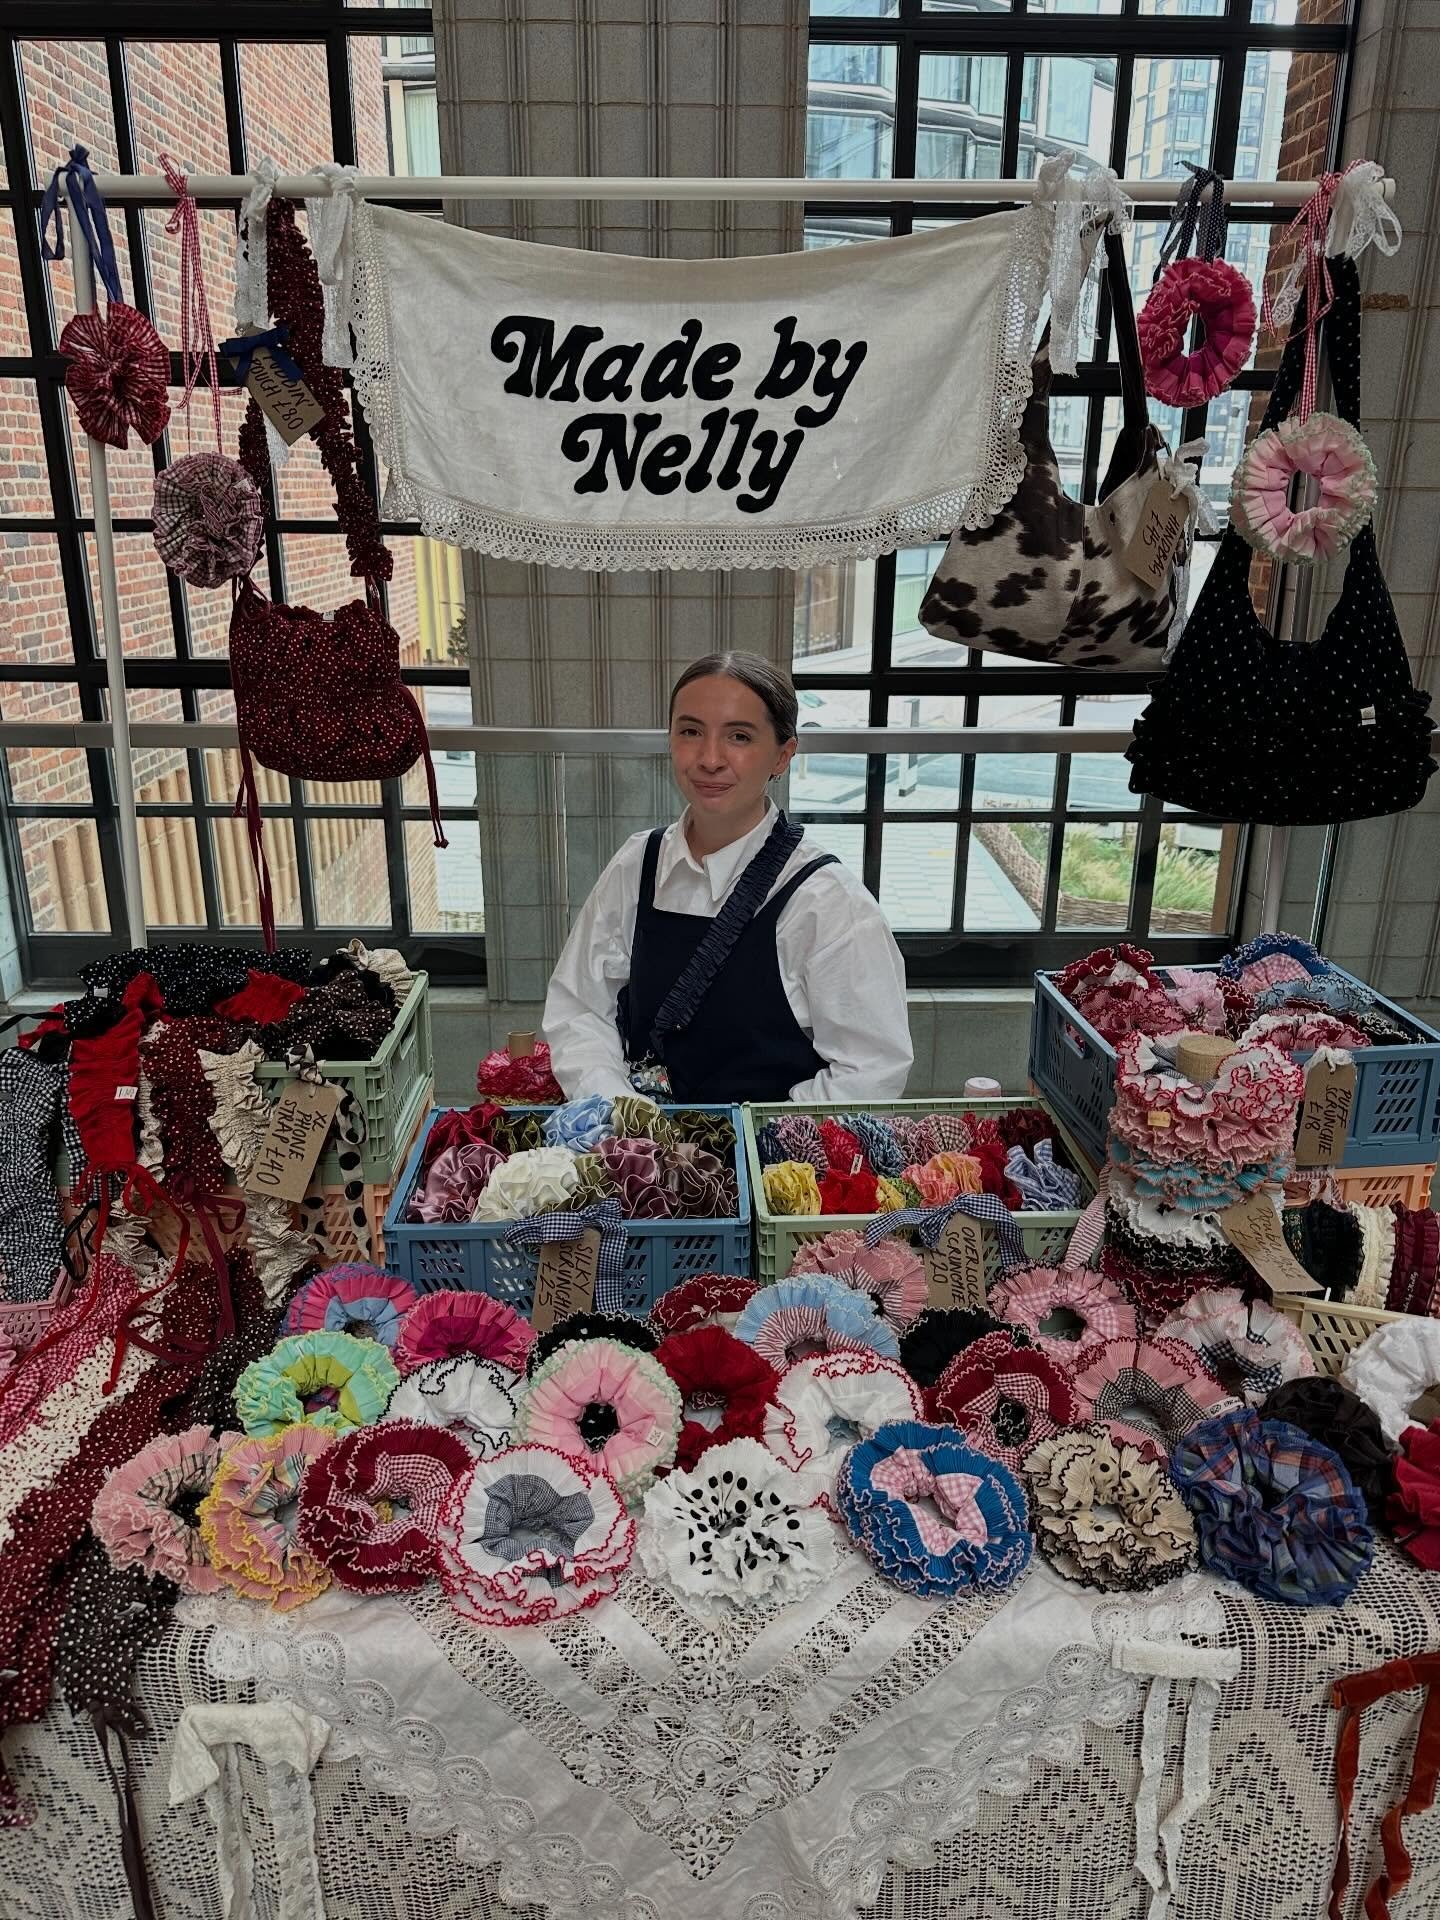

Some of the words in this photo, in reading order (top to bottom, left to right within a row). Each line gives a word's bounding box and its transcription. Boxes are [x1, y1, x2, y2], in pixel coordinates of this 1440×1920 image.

[250, 357, 282, 398] POUCH
[272, 400, 304, 430] £80
[490, 315, 741, 403] Made
[754, 315, 868, 428] by
[560, 406, 805, 514] Nelly
[271, 1099, 297, 1144] STRAP
[312, 1110, 328, 1132] XL
[1304, 1101, 1323, 1131] £18
[1318, 1084, 1339, 1156] SCRUNCHIE
[1336, 1087, 1352, 1129] PUFF
[288, 1109, 312, 1161] PHONE
[256, 1146, 286, 1185] £40
[538, 1261, 557, 1306] £25
[553, 1241, 574, 1321] SCRUNCHIE
[572, 1243, 593, 1296] SILKY
[929, 1248, 949, 1284] £20
[945, 1229, 966, 1304] SCRUNCHIE
